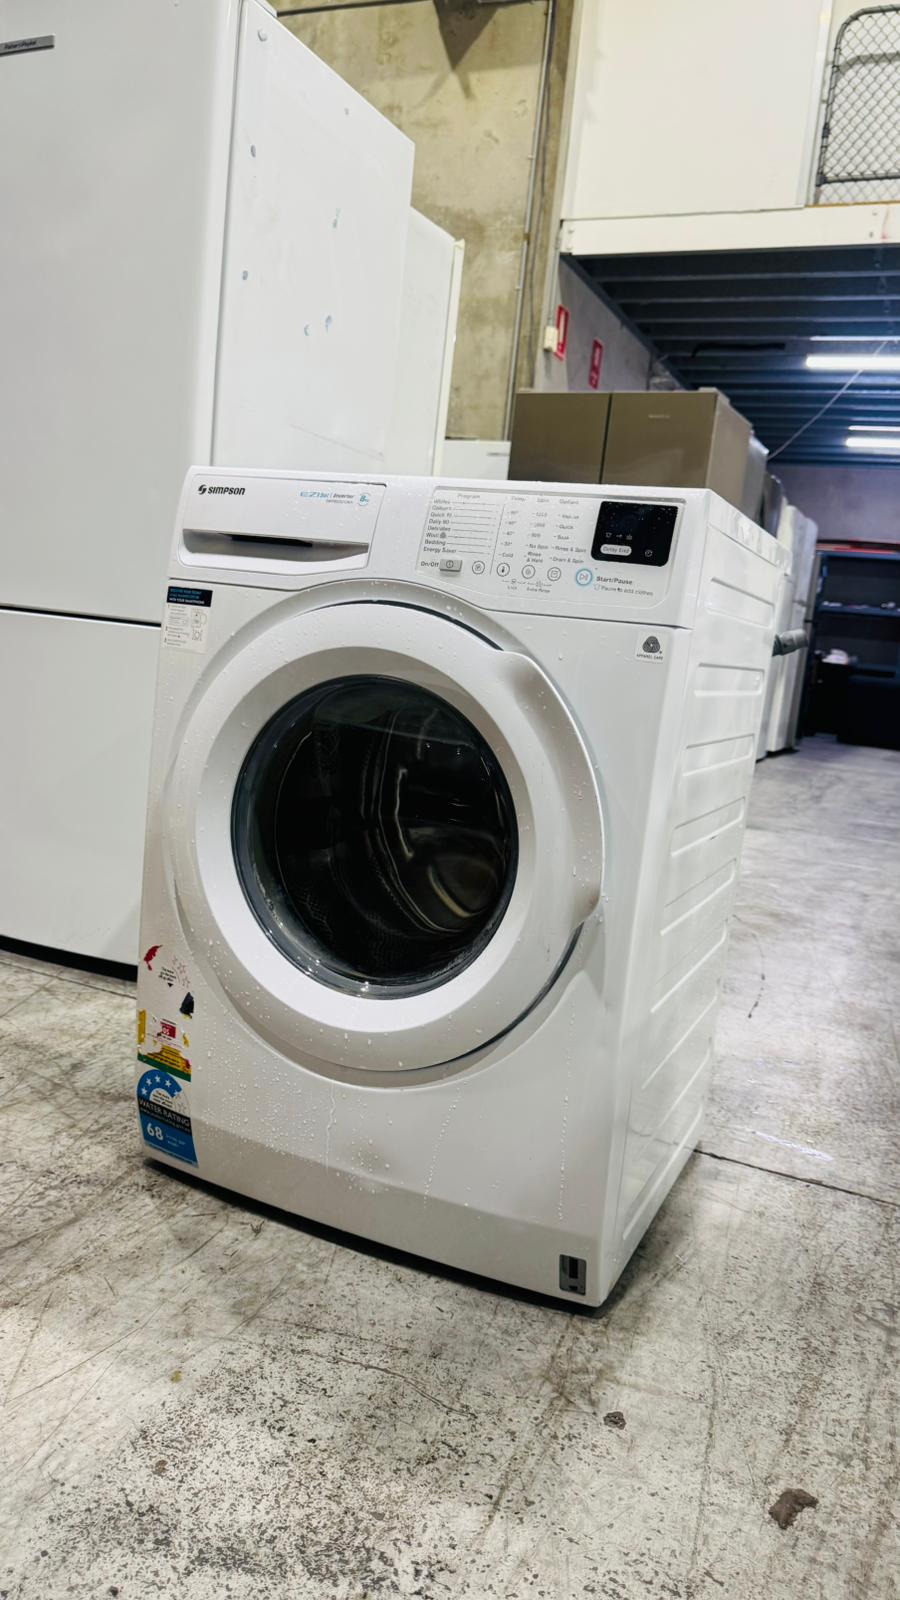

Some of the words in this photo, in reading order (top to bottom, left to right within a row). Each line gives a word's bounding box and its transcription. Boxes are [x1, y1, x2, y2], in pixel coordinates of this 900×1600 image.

[208, 486, 246, 496] SIMPSON
[420, 560, 440, 568] On/Off
[596, 576, 633, 585] Start/Pause
[138, 1099, 162, 1115] WATER
[162, 1109, 190, 1127] RATING
[147, 1122, 164, 1141] 68
